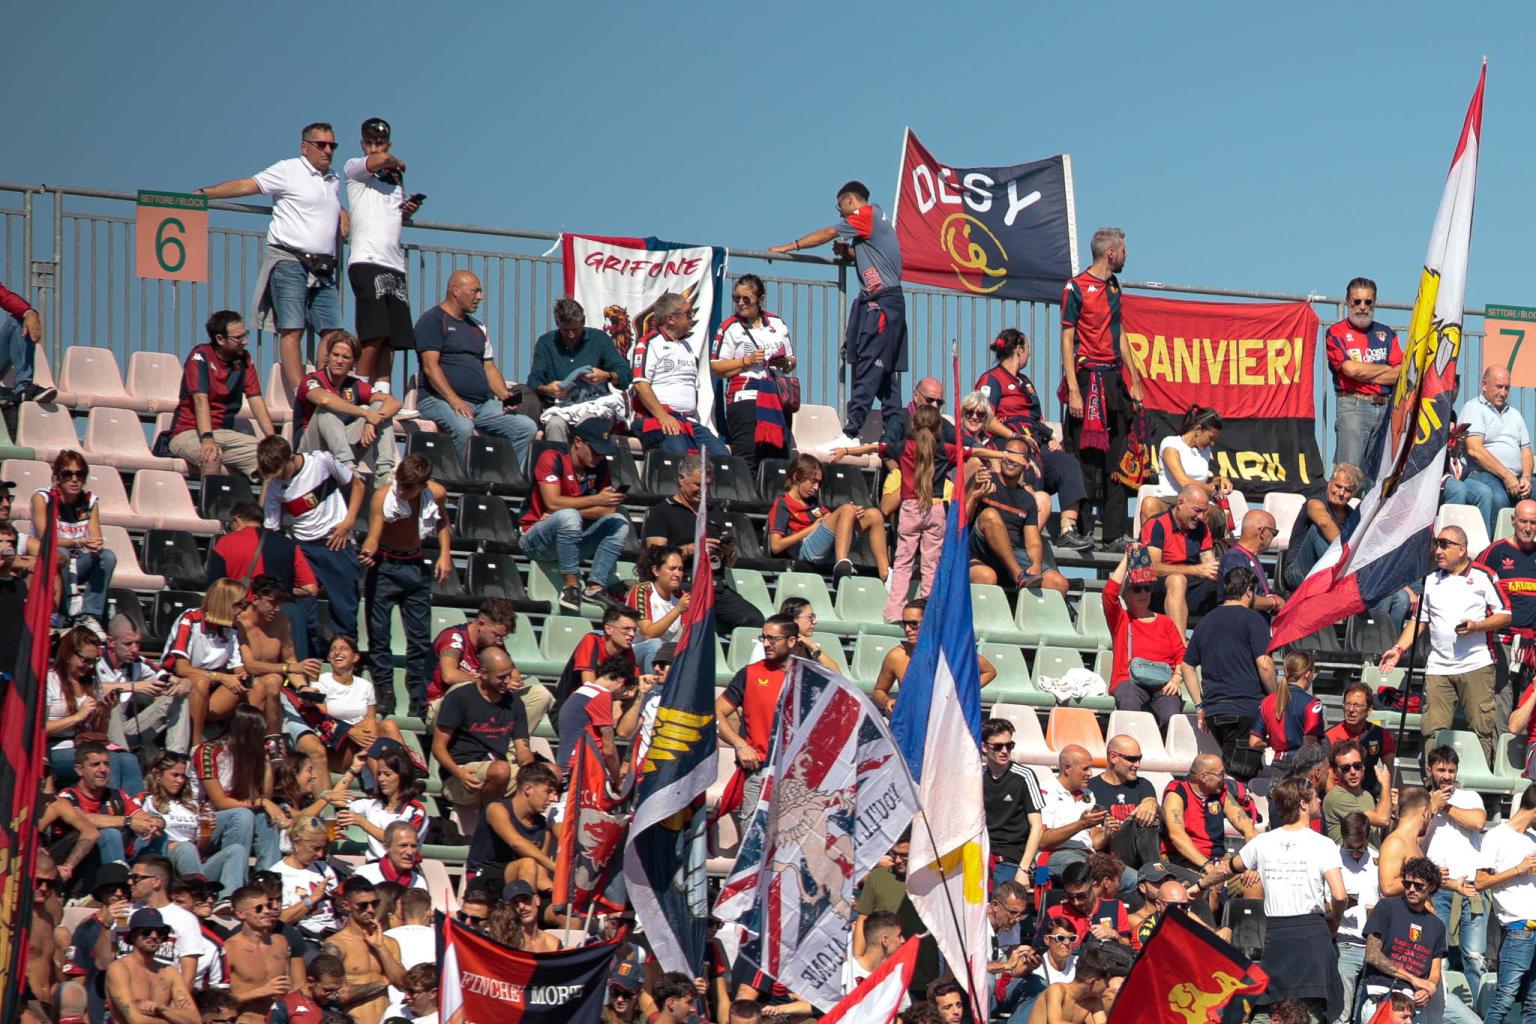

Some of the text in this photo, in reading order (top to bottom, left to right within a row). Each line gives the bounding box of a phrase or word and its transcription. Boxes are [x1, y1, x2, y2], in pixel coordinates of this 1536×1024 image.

[912, 163, 1042, 226] DESY
[155, 217, 187, 272] 6
[584, 251, 703, 278] GRIFONE
[1126, 332, 1303, 385] RANVIERI
[1499, 328, 1526, 376] 7
